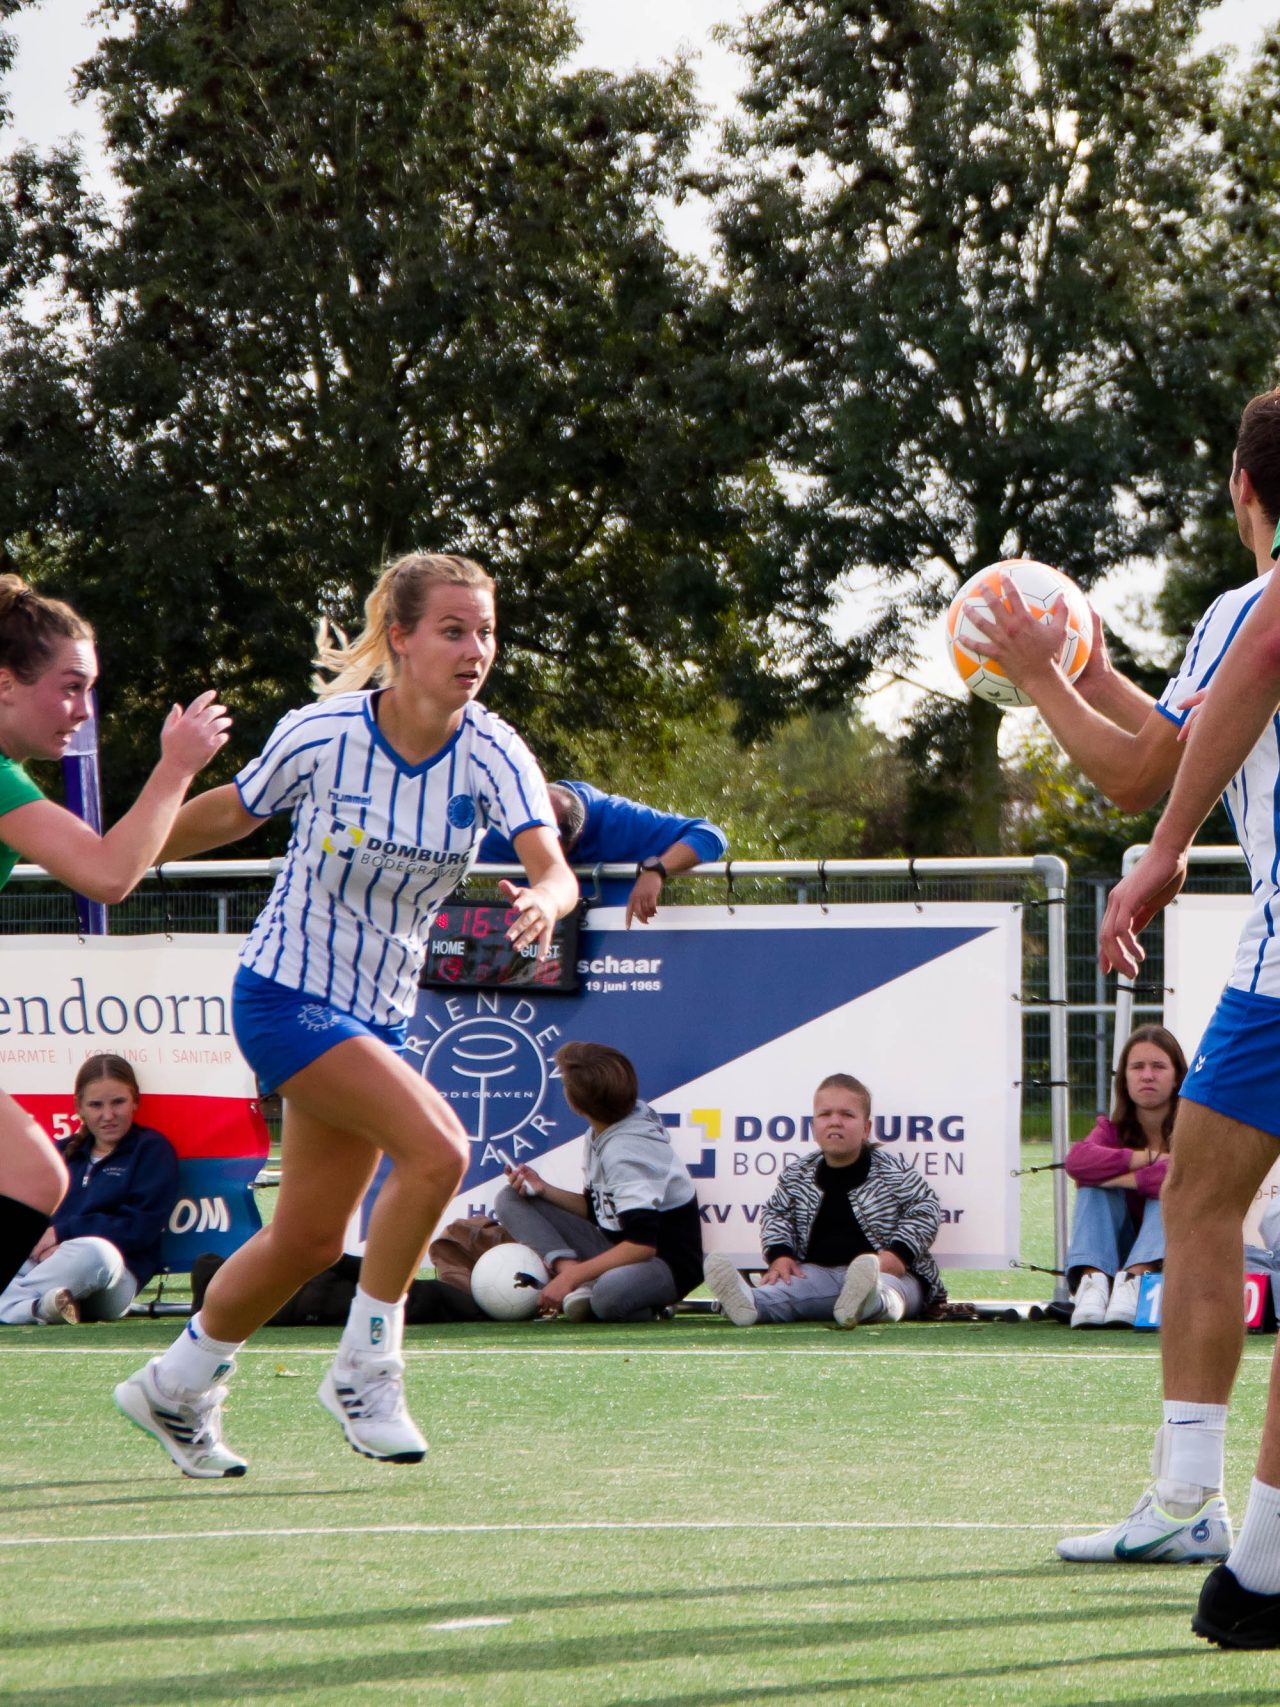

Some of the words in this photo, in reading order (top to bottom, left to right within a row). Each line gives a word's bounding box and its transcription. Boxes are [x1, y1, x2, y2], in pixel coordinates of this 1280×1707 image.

[432, 941, 465, 956] HOME
[520, 944, 560, 959] GUST
[576, 955, 662, 975] schaar
[585, 981, 601, 992] 19
[603, 981, 627, 993] juni
[630, 981, 661, 992] 1965
[172, 1050, 232, 1065] SANITAIR
[439, 1090, 534, 1099] ODEGRAVEN
[734, 1115, 965, 1142] DOURG
[733, 1152, 964, 1176] BODVEN
